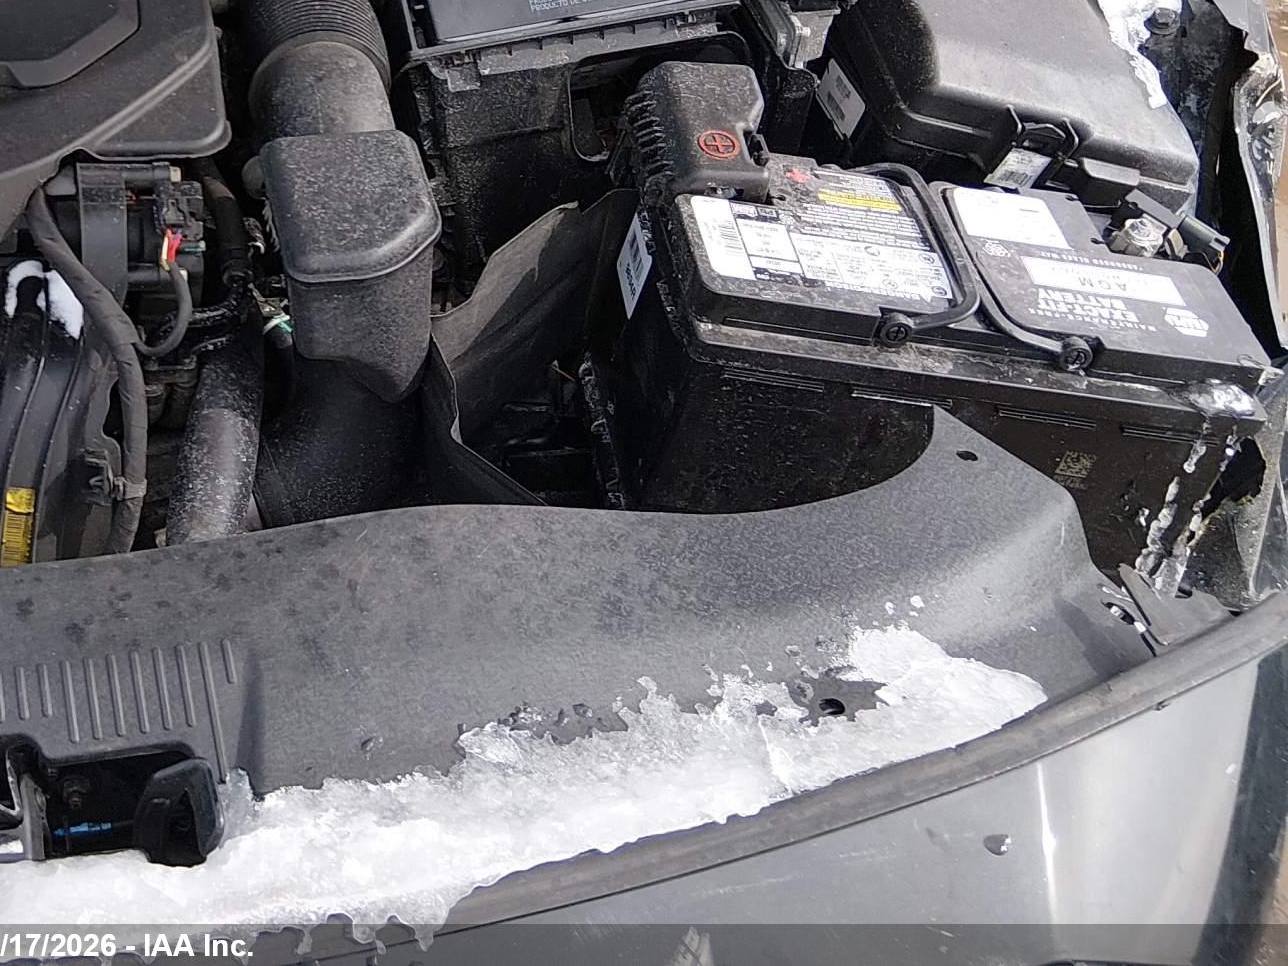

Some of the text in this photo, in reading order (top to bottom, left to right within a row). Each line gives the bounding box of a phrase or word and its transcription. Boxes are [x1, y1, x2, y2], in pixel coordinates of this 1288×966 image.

[530, 0, 568, 11] PRODUCTO
[1078, 277, 1127, 291] AGM
[1038, 288, 1128, 311] BATTERY
[1038, 299, 1140, 323] EXACT-FIT
[1028, 308, 1158, 332] MAINTENANCE-FREE
